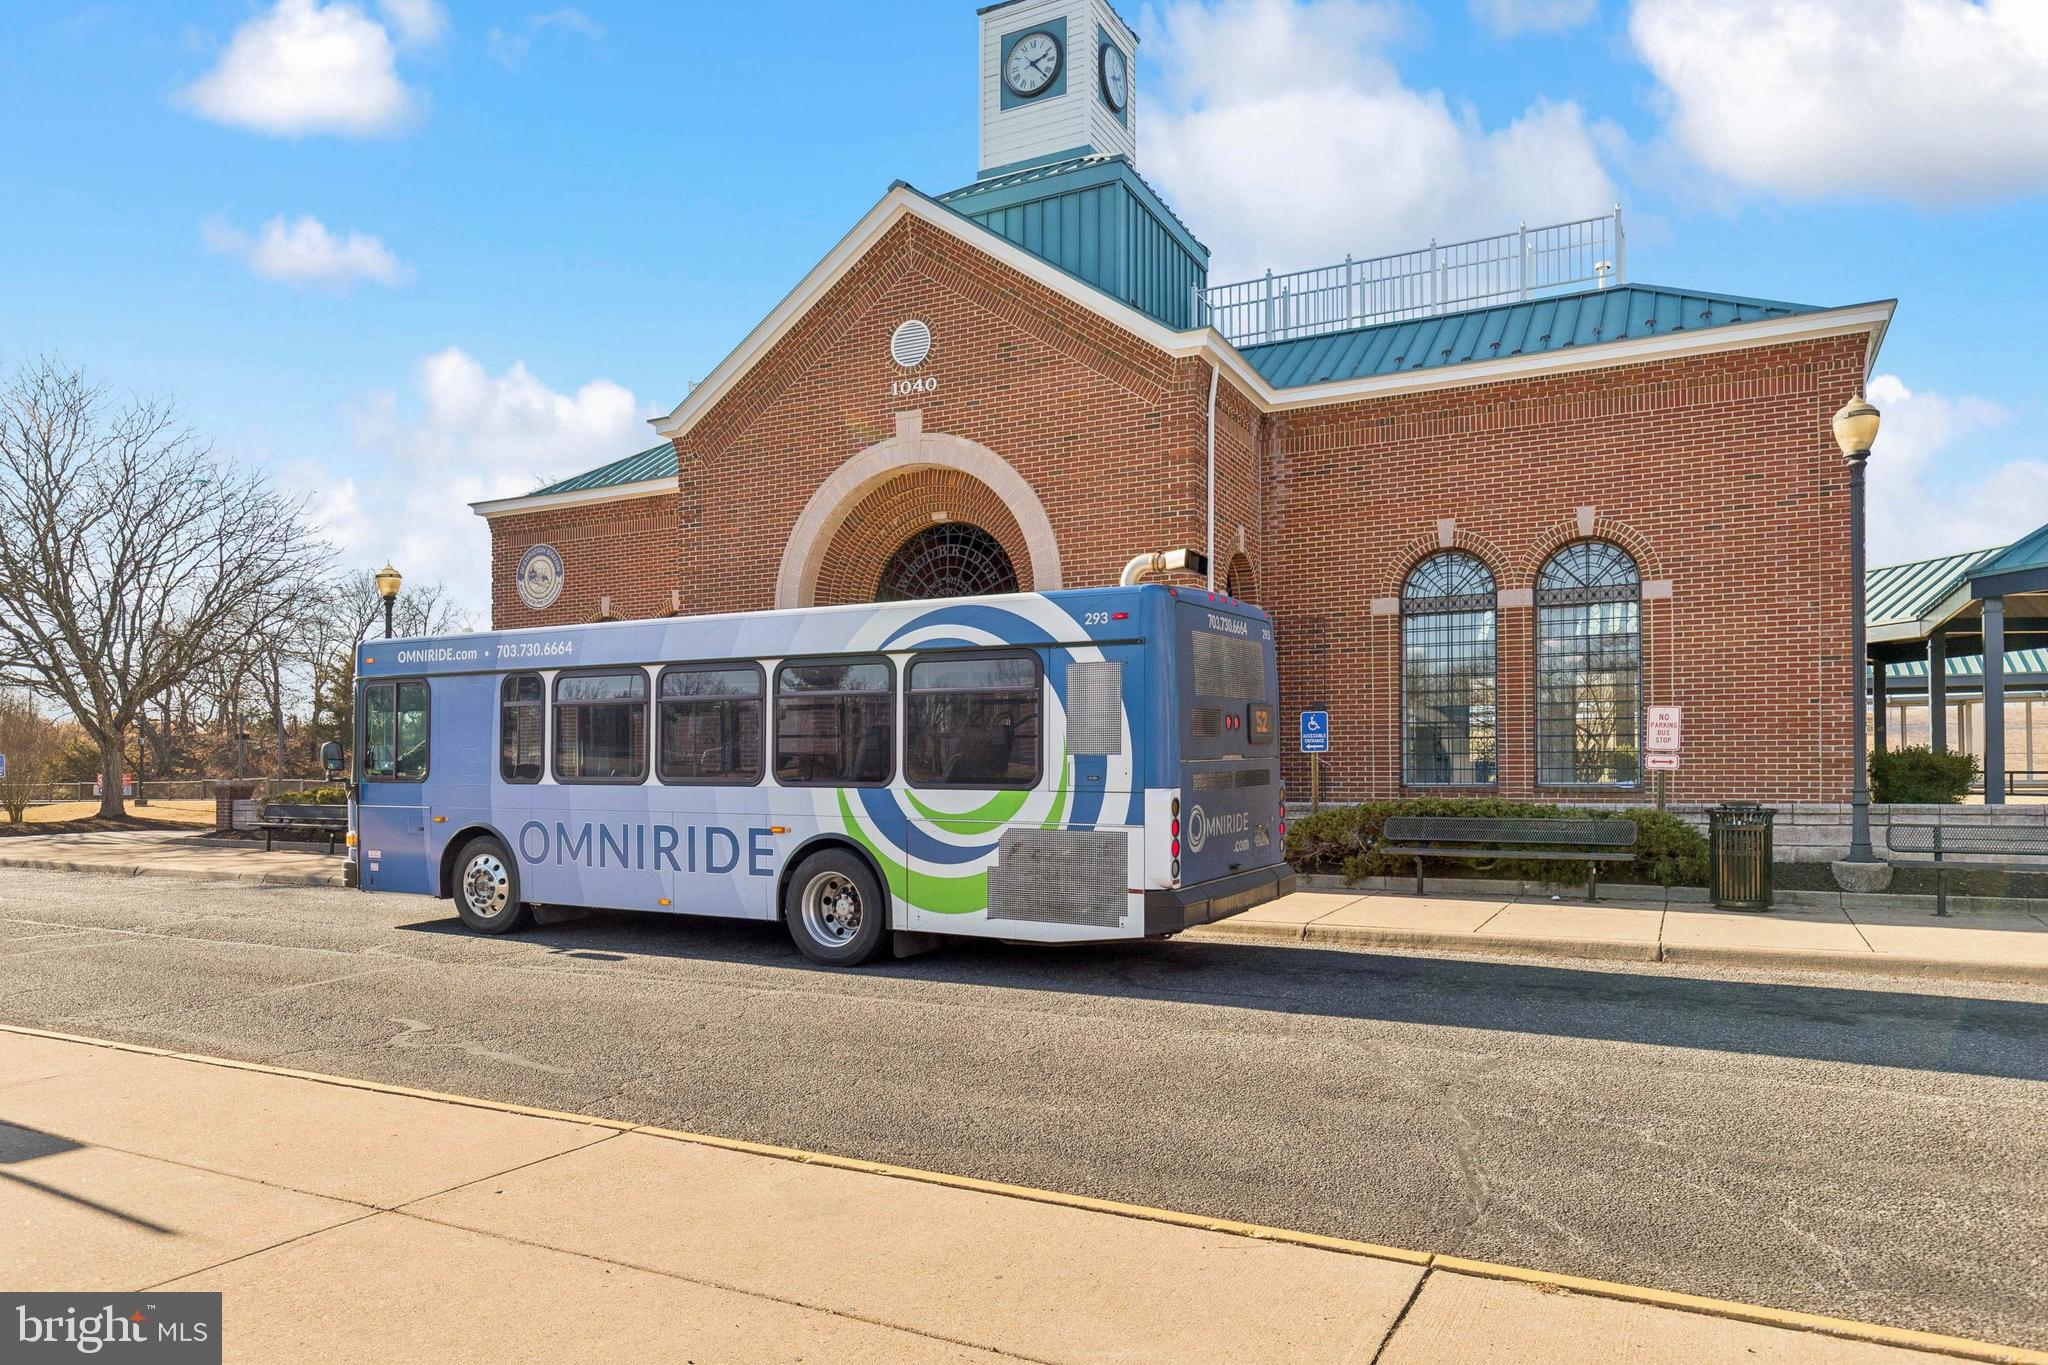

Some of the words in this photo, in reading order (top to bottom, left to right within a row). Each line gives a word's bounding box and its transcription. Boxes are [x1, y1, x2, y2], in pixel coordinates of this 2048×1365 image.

[891, 377, 937, 395] 1040
[897, 544, 1001, 592] WOODBRIDGE
[1084, 611, 1109, 625] 293
[1207, 613, 1248, 636] 703.730.6664
[397, 649, 477, 664] OMNIRIDE.com
[496, 640, 573, 658] 703.730.6664
[1650, 721, 1678, 729] PARKING
[1187, 804, 1249, 853] OMNIRIDE
[518, 820, 775, 877] OMNIRIDE
